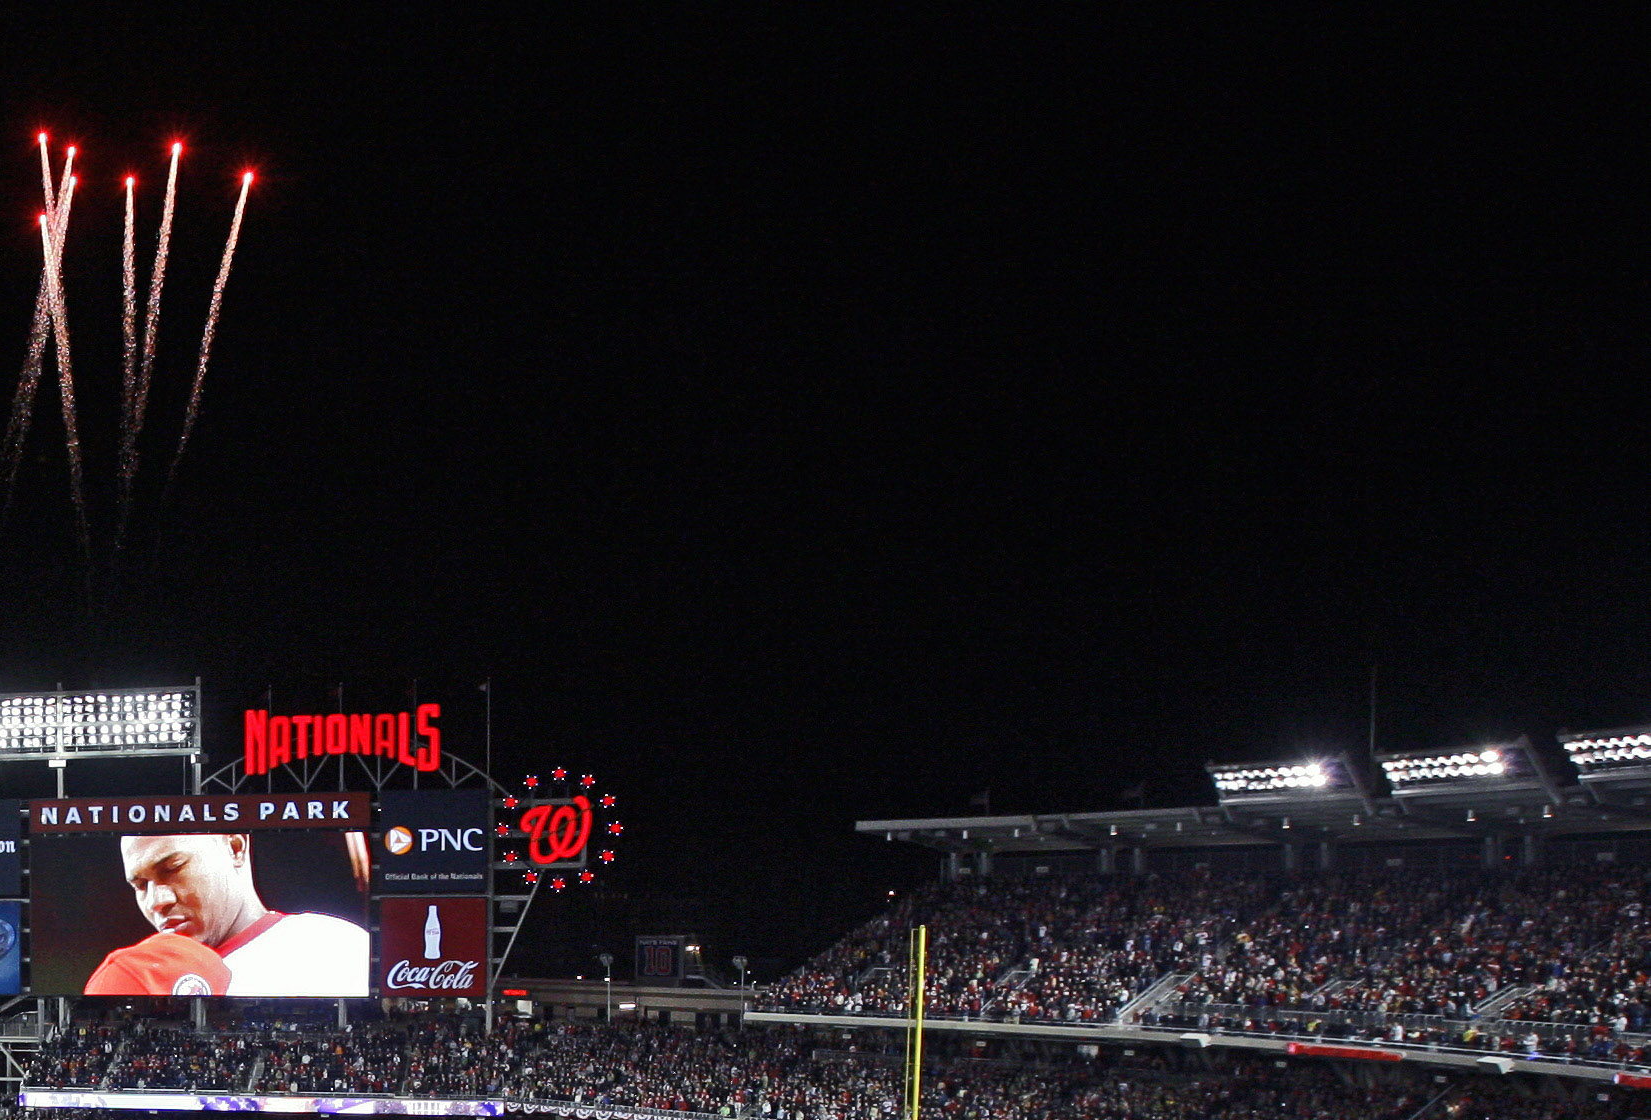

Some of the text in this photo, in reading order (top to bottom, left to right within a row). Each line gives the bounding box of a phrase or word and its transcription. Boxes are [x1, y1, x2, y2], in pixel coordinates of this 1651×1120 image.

[244, 703, 441, 775] NATIONALS
[40, 800, 350, 825] NATIONALS PARK
[418, 828, 483, 852] PNC
[450, 872, 483, 880] Nationals
[386, 959, 480, 990] Coca-Cola
